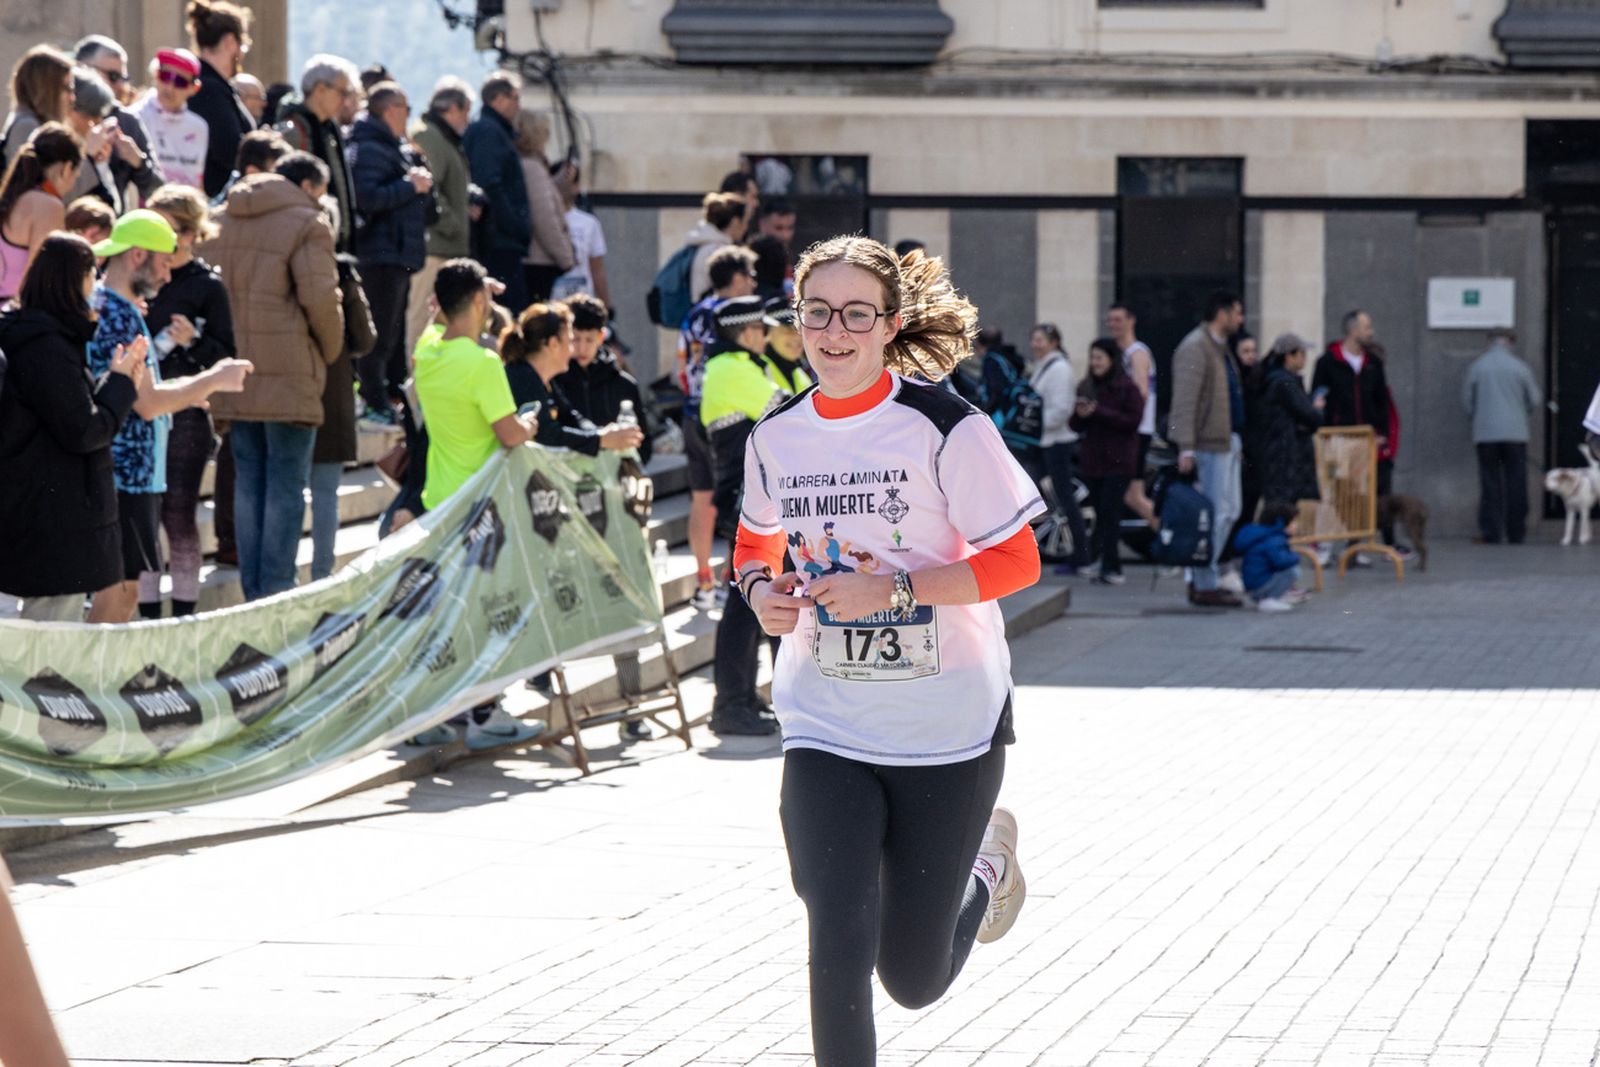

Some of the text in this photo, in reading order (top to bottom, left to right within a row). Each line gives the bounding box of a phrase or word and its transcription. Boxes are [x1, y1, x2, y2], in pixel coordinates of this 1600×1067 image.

[786, 473, 837, 489] CARRERA
[840, 469, 909, 486] CAMINATA
[815, 493, 875, 516] MUERTE
[843, 627, 902, 662] 173
